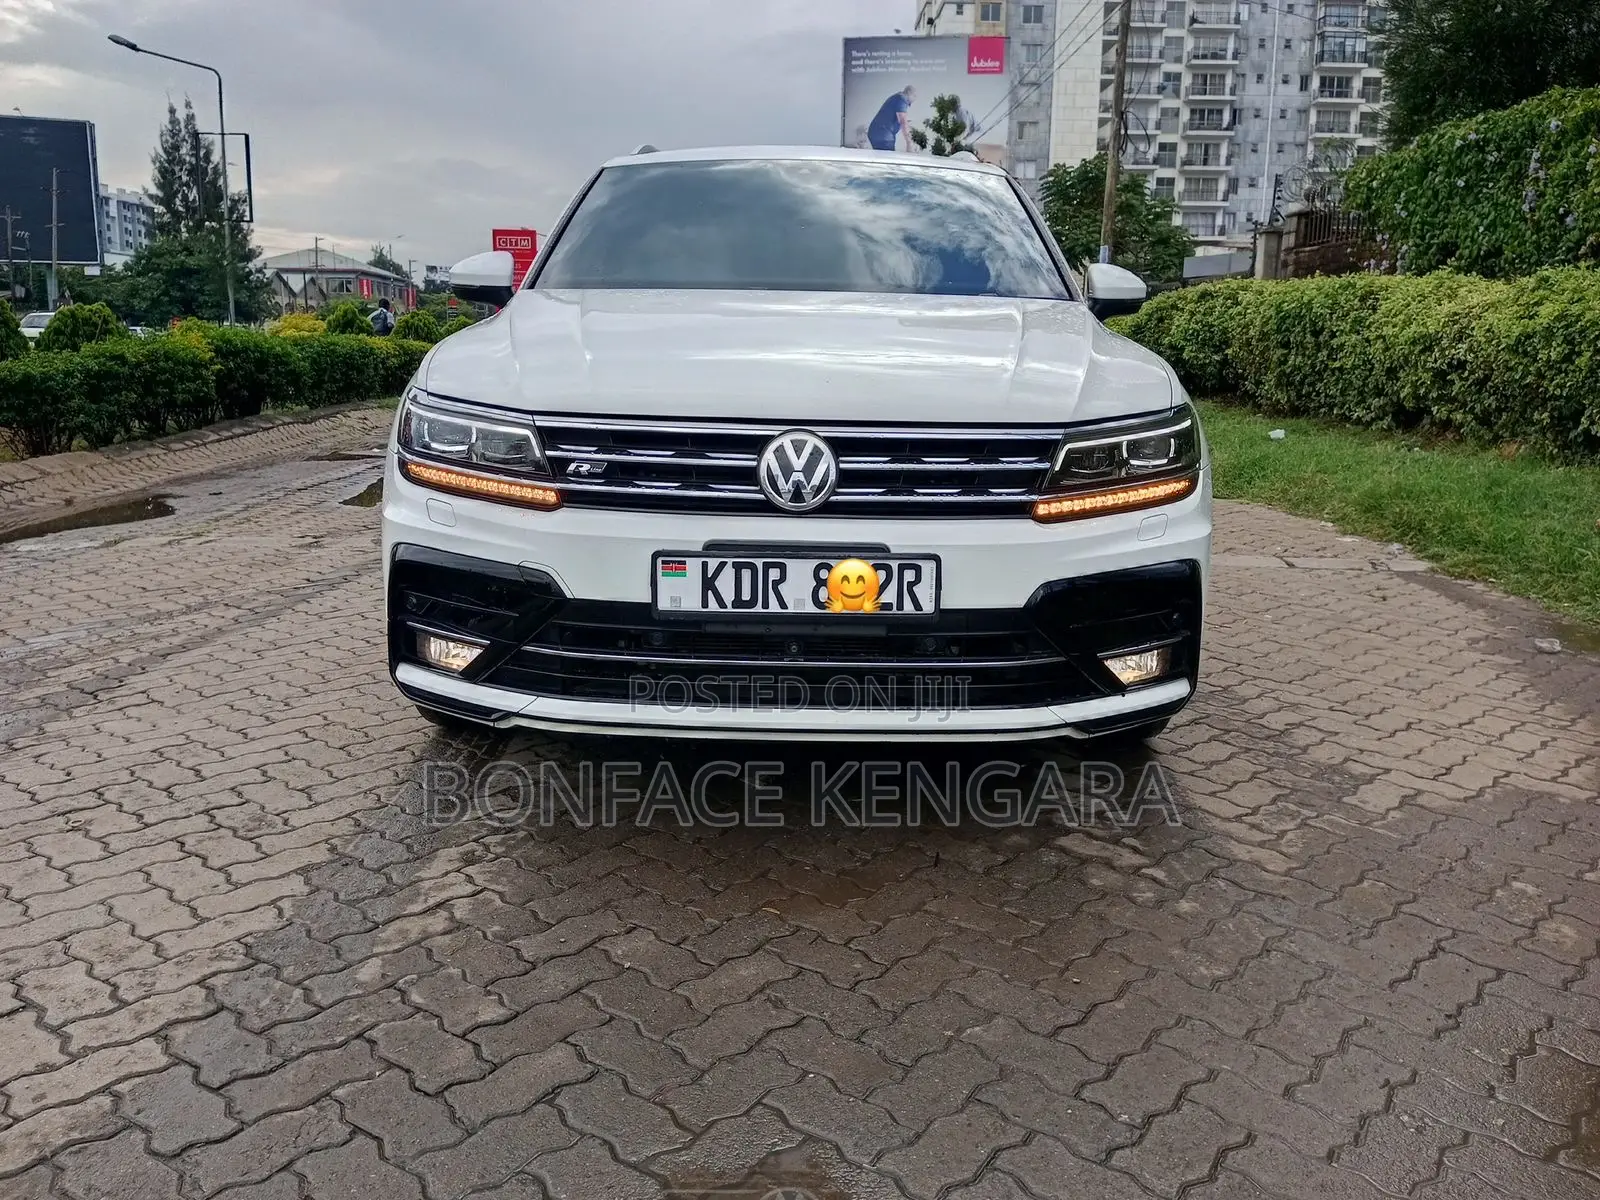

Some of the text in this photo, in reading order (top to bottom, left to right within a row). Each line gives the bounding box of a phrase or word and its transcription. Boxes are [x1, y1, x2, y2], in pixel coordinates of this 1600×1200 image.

[971, 56, 1000, 67] Jubilee
[499, 237, 530, 248] CTM
[701, 560, 788, 610] KDR
[811, 562, 923, 612] 82R
